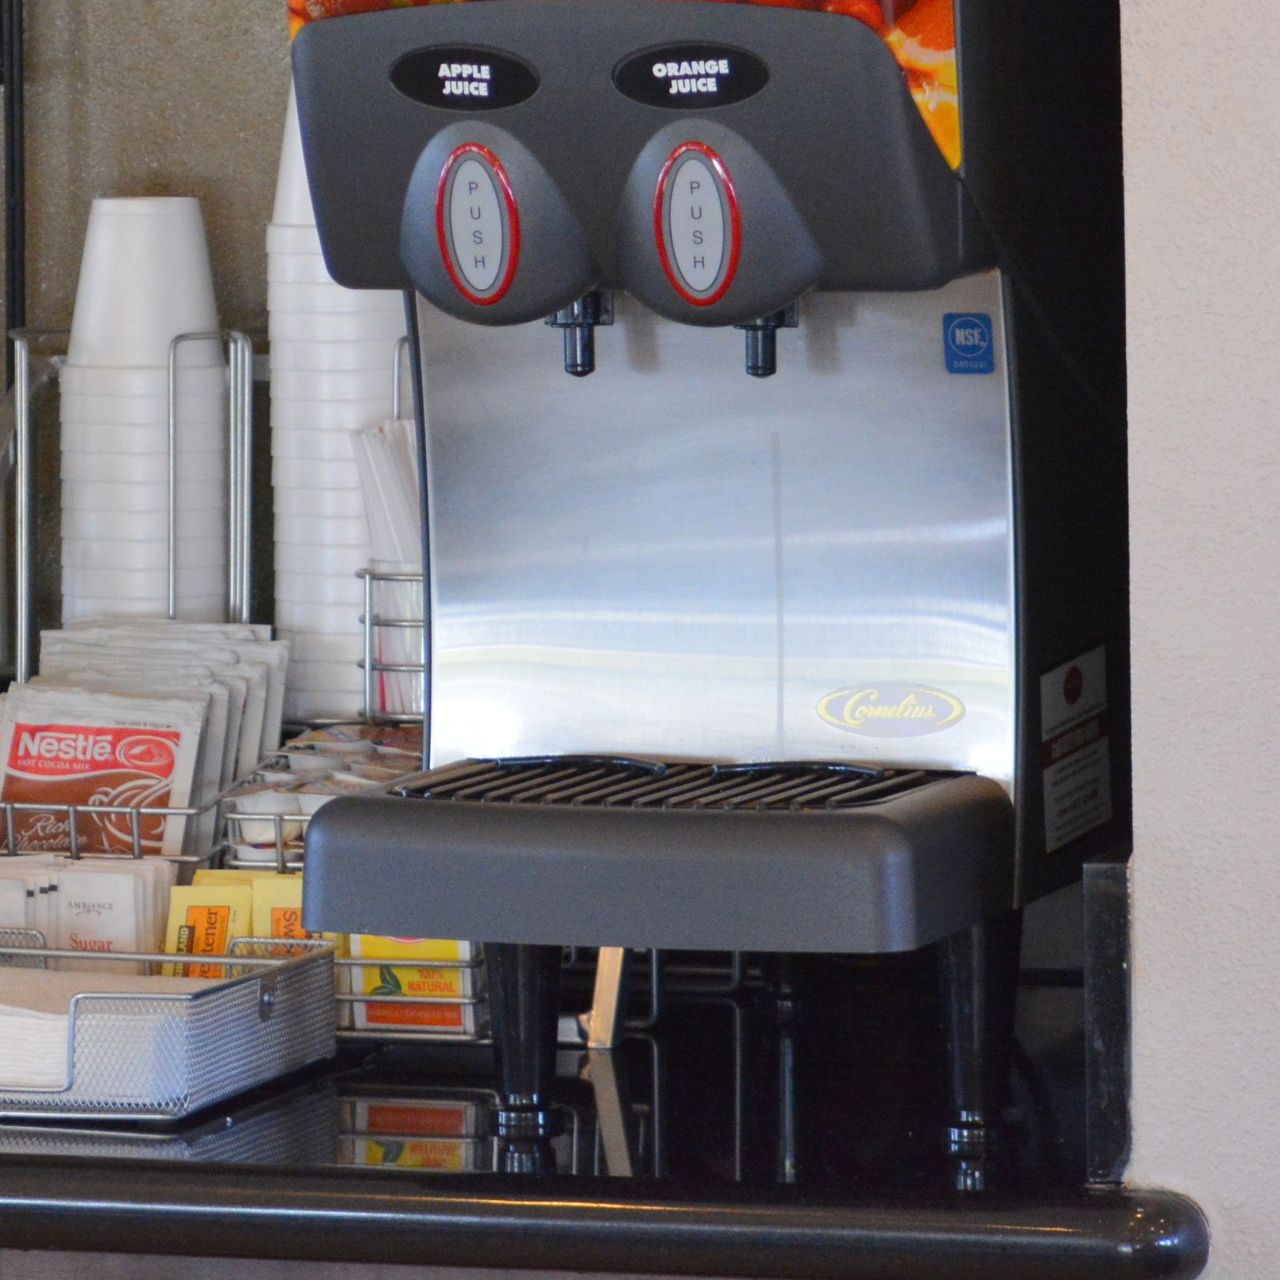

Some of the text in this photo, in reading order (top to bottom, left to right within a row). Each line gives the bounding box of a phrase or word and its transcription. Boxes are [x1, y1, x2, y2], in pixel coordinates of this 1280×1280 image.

[438, 63, 490, 79] APPLE
[652, 59, 730, 78] ORANGE
[442, 81, 489, 97] JUICE
[669, 77, 717, 94] JUICE
[843, 688, 937, 725] Cornelius
[17, 731, 112, 761] Nestlé
[38, 759, 70, 769] COCOA
[69, 932, 114, 952] Sugar
[407, 980, 455, 993] NATURAL
